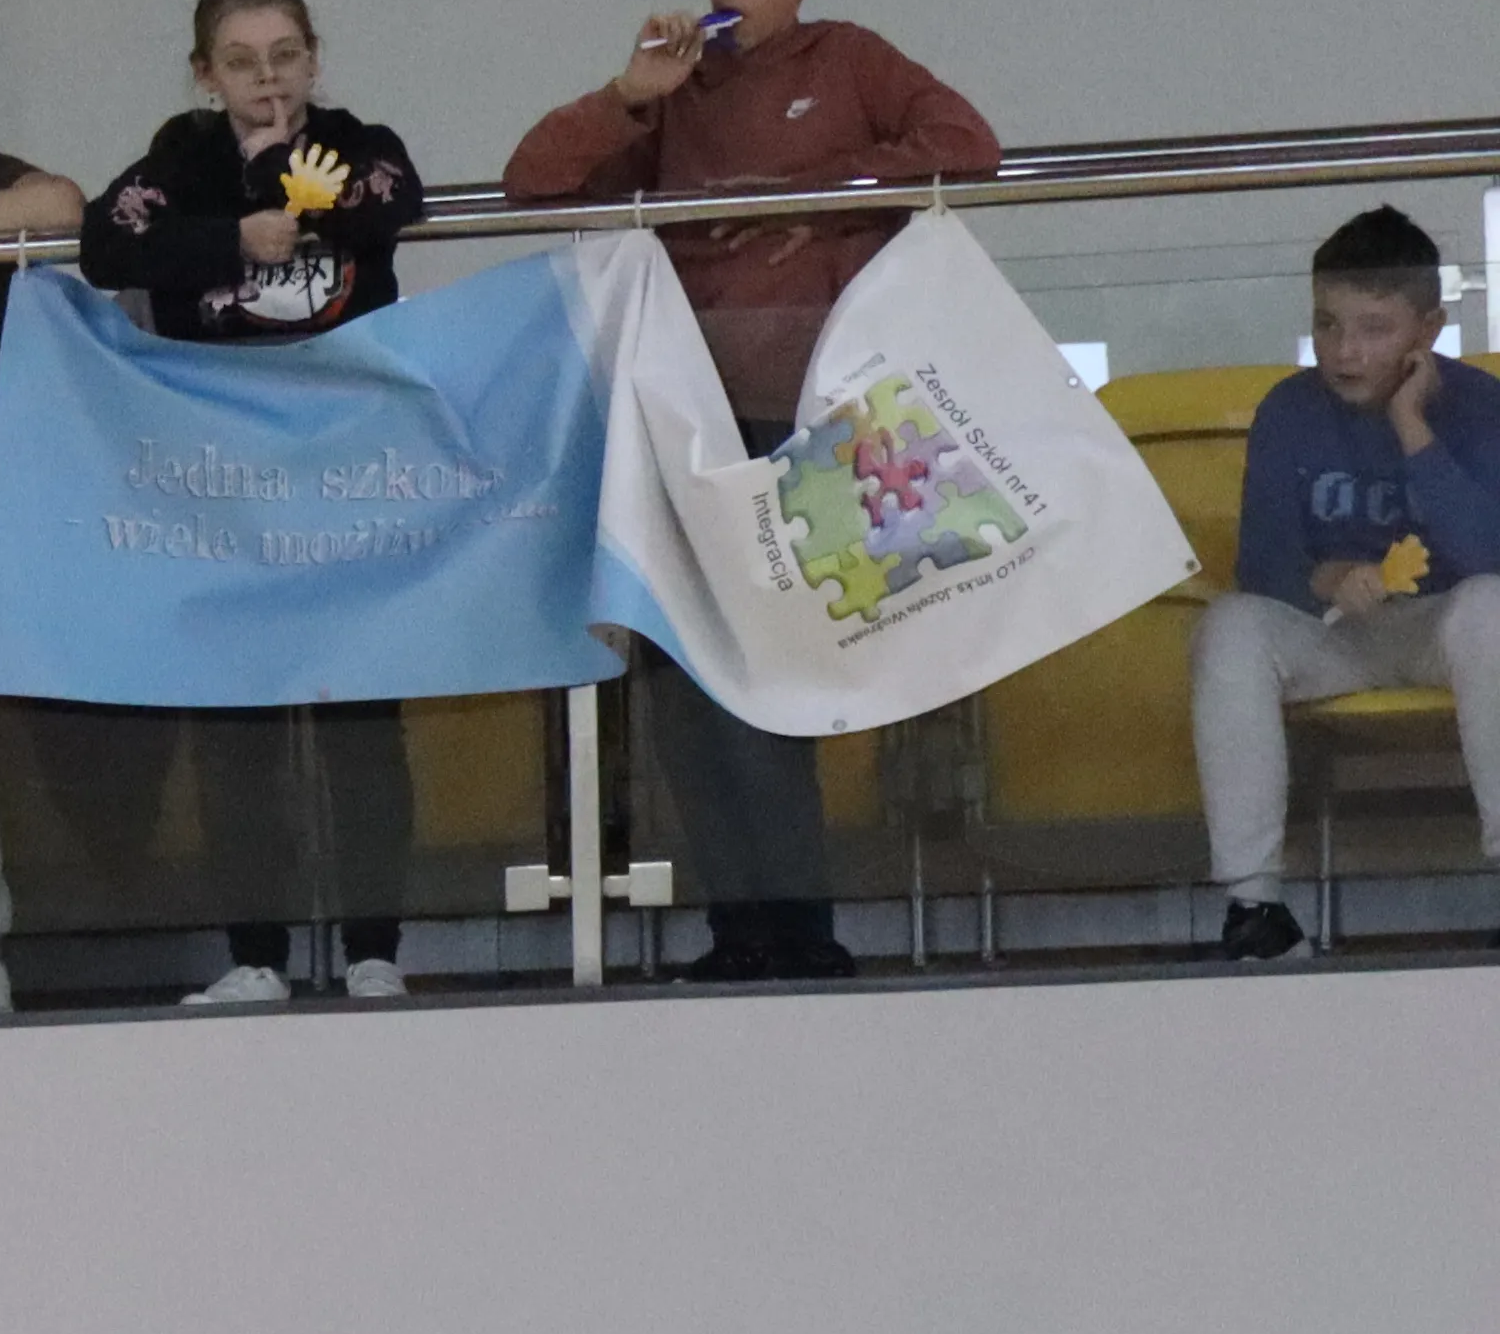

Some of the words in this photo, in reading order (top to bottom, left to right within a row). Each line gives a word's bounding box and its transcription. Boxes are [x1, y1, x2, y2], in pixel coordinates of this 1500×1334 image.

[915, 362, 972, 428] Zespół
[965, 427, 1013, 475] Szkół
[125, 438, 297, 502] Jedna
[102, 507, 238, 562] wiele
[751, 490, 795, 593] Integracja
